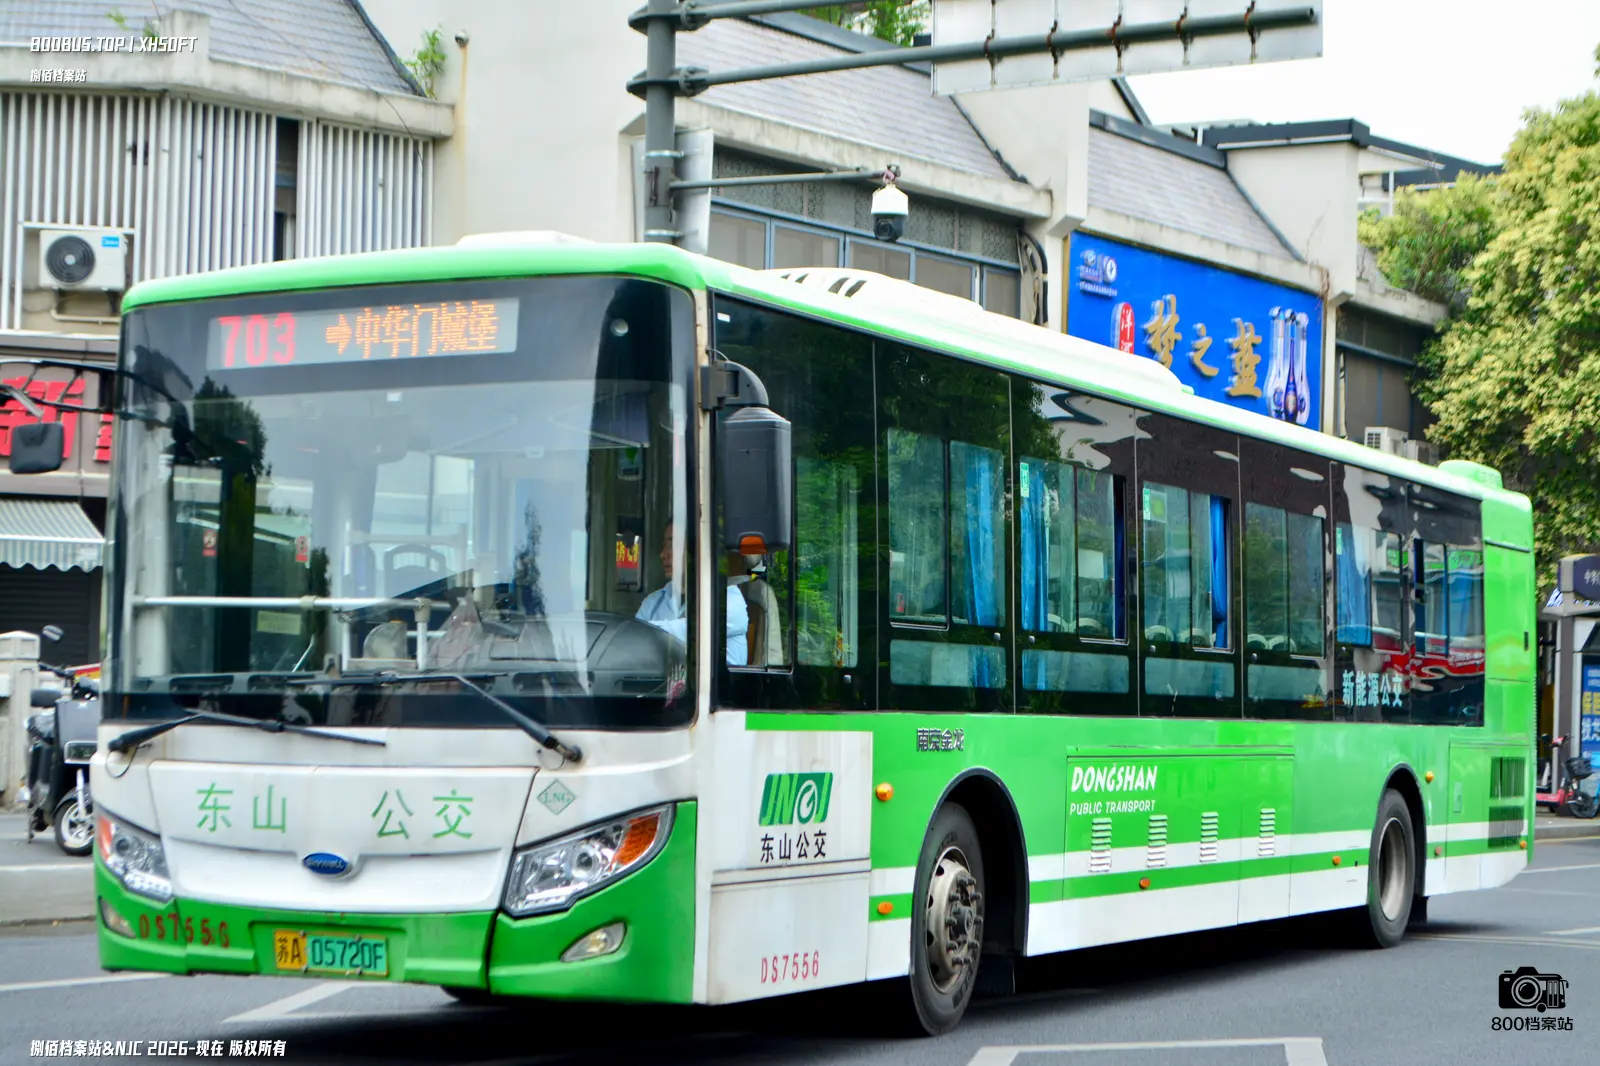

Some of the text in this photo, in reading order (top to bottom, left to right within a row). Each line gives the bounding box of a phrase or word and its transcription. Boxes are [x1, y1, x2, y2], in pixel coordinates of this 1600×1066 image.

[219, 312, 297, 368] 703
[1342, 669, 1404, 708] 新能源公交
[1070, 763, 1158, 793] DONGSHAN
[1069, 799, 1156, 816] PUBLIC TRANSPORT
[760, 829, 827, 863] 东山公交
[760, 950, 820, 984] DS7556
